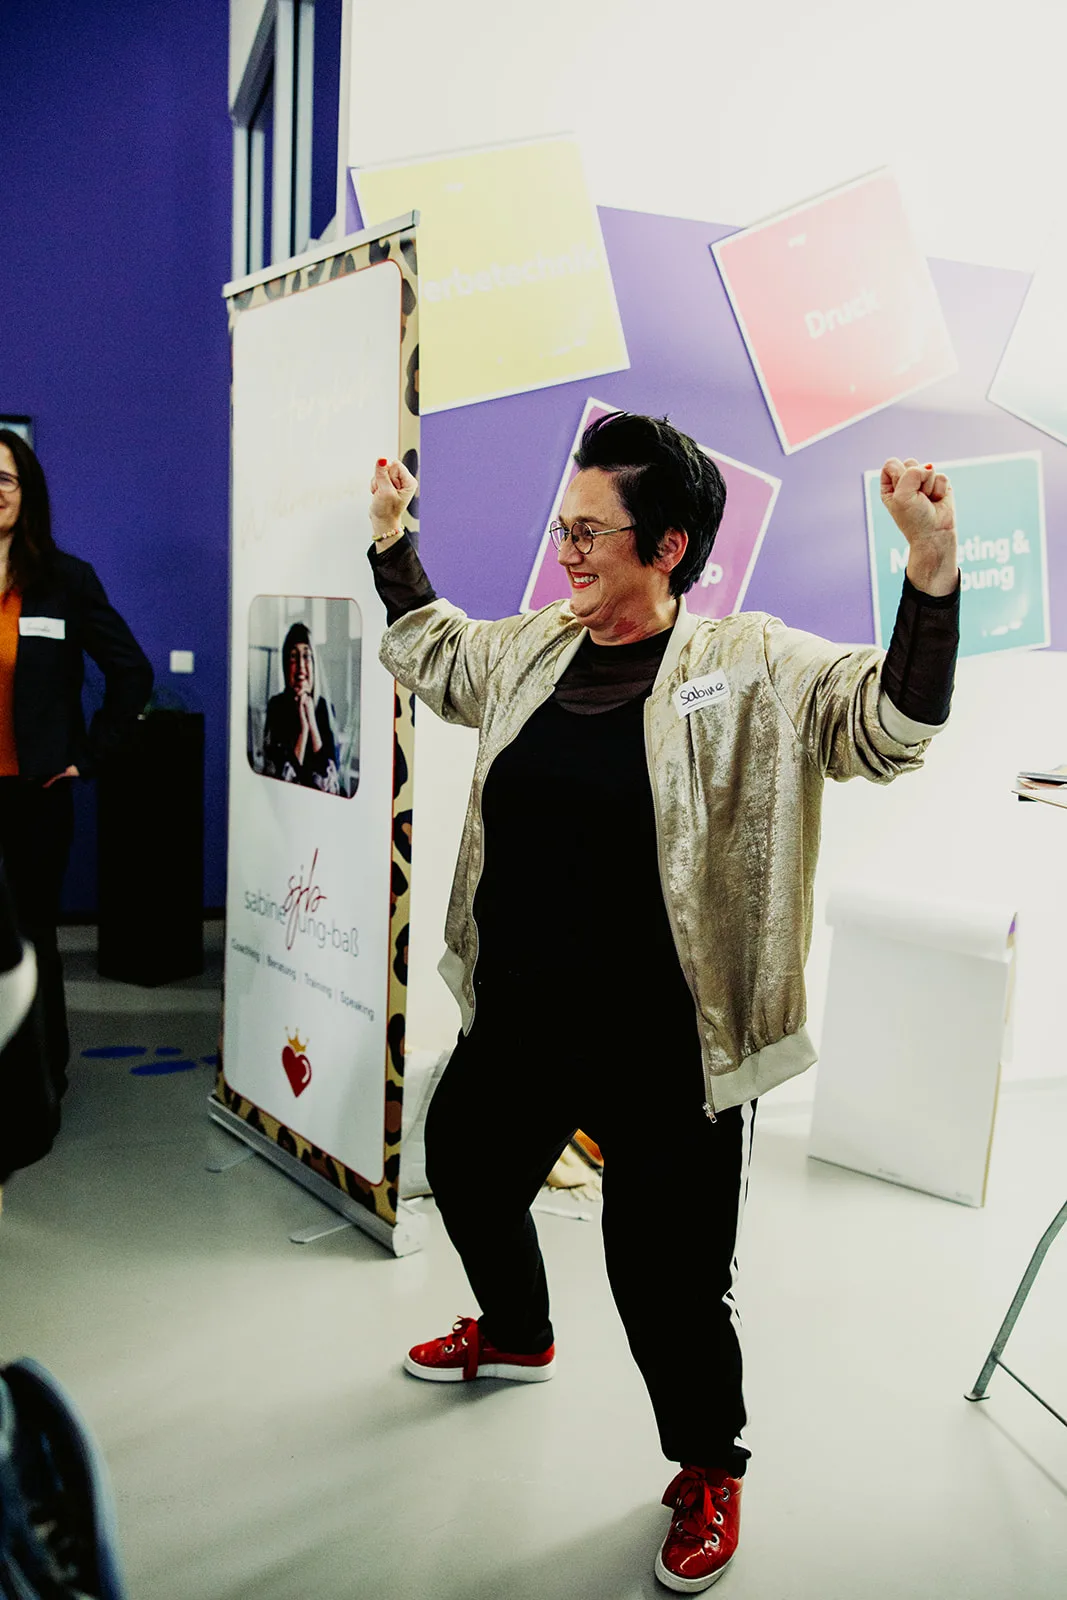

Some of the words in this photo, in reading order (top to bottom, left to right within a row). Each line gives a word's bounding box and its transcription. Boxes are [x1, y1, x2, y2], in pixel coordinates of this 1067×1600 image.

[418, 242, 602, 304] erbetechnik
[804, 287, 881, 339] Druck
[1012, 529, 1031, 555] &
[680, 682, 725, 706] Sabine
